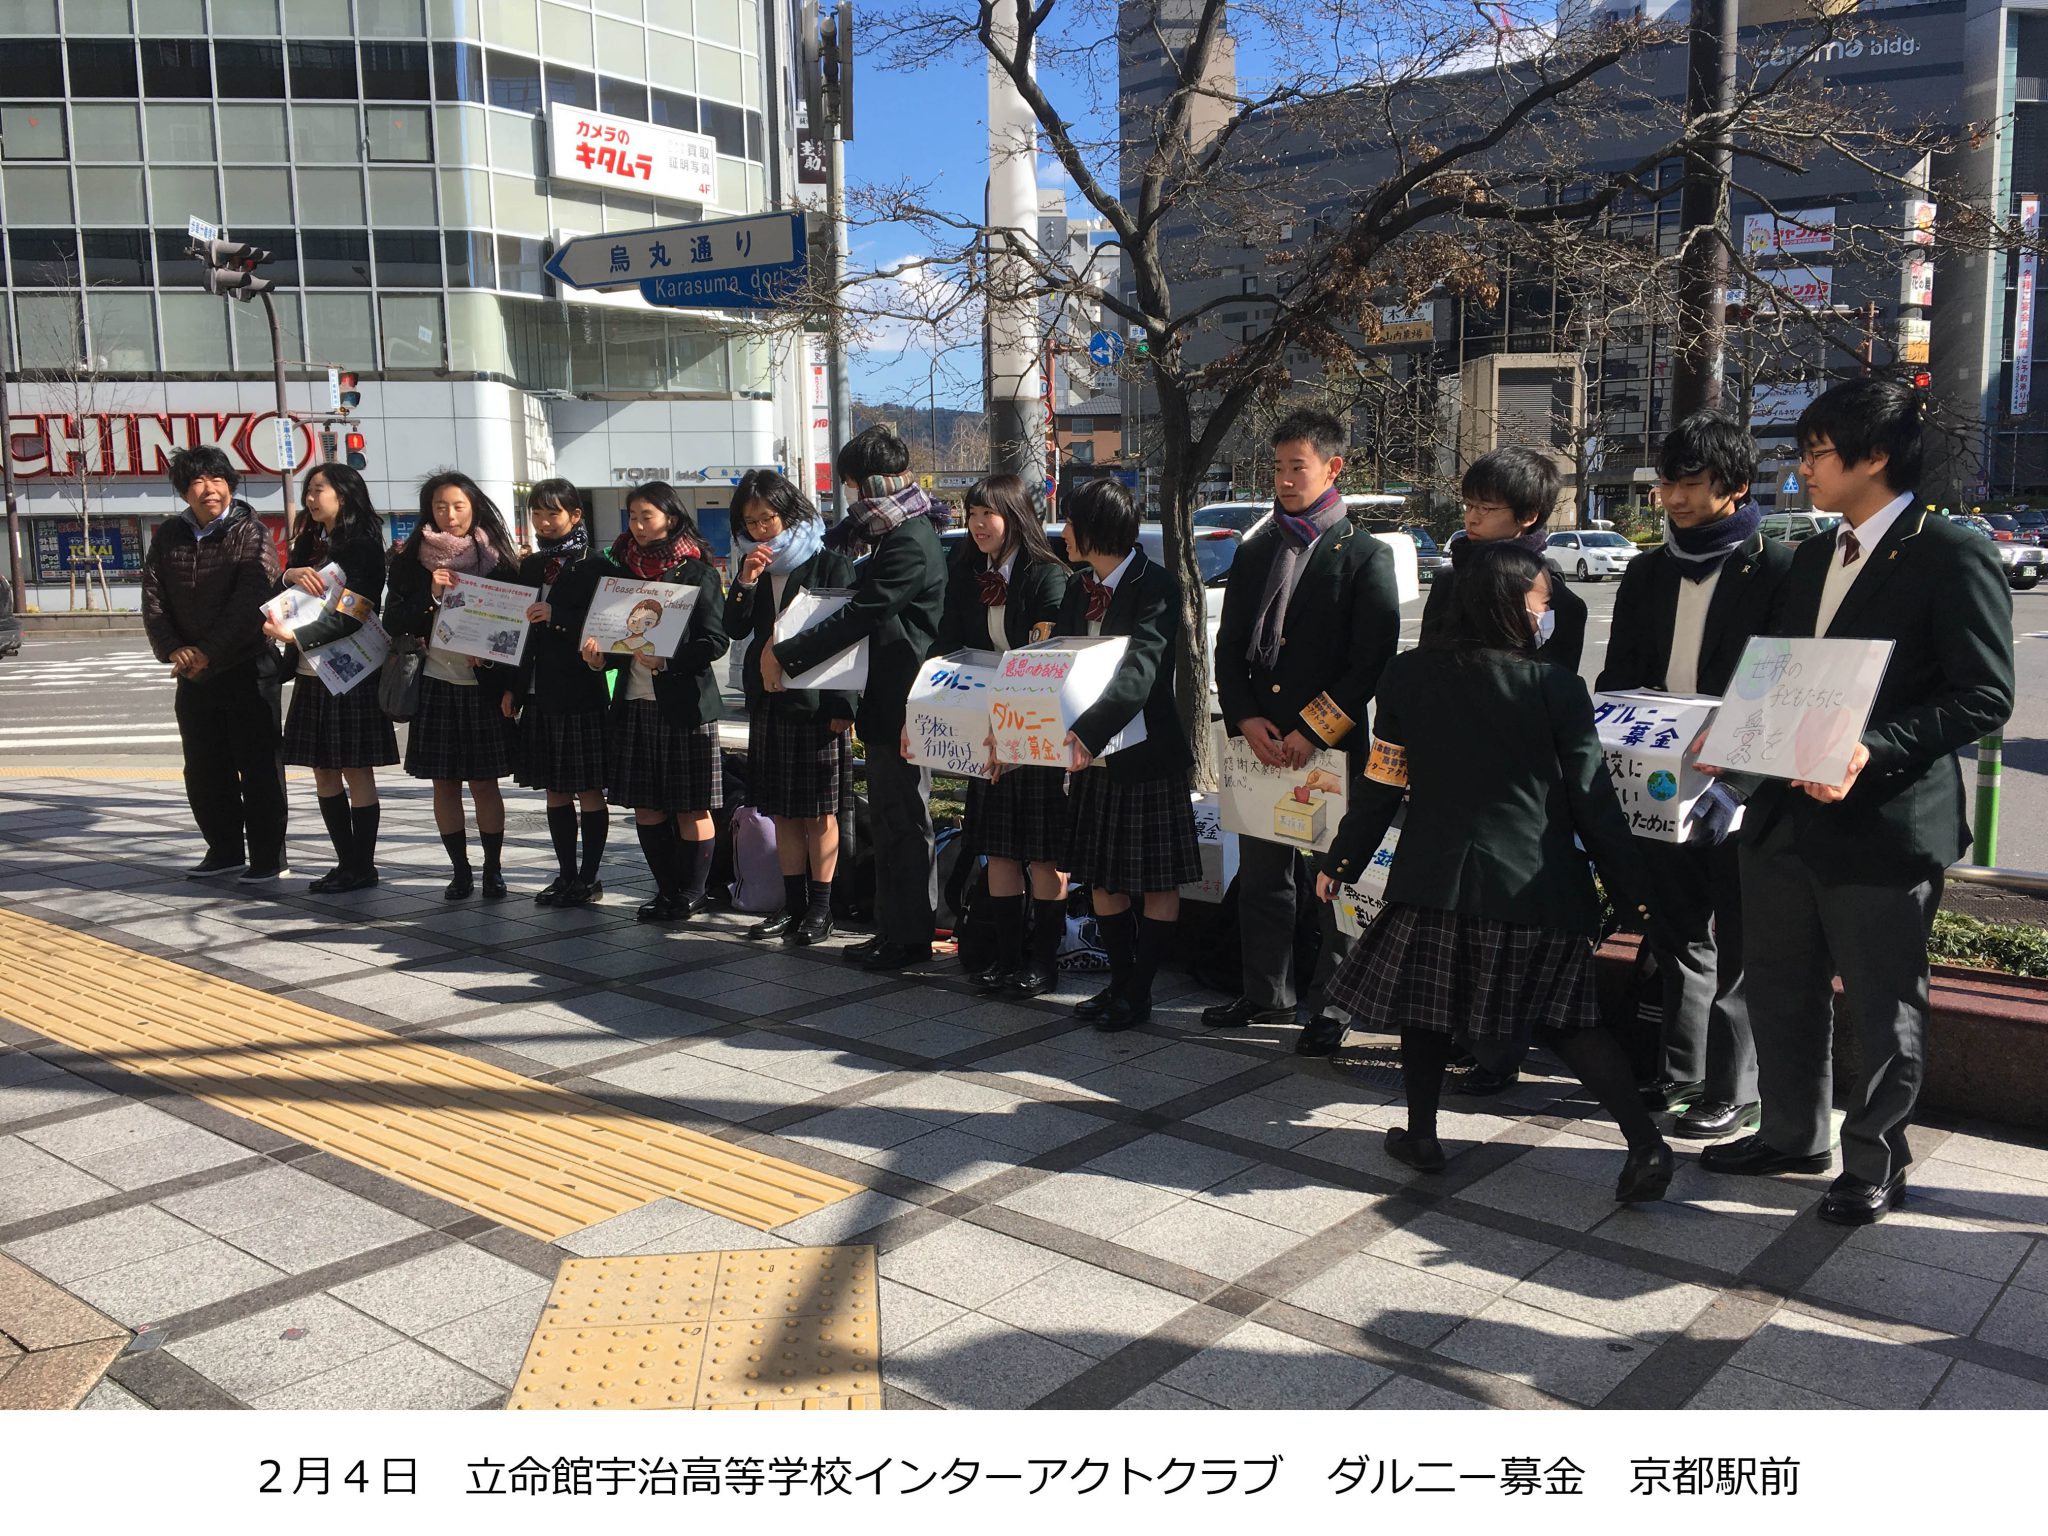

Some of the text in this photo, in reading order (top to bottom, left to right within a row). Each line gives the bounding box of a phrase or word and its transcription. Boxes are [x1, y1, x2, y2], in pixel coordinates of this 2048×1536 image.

[576, 121, 630, 145] カメラの
[576, 142, 653, 181] キタムラ
[698, 183, 711, 195] 4F
[610, 230, 752, 274] 烏丸通り
[655, 275, 740, 299] Karasuma
[604, 578, 674, 596] Please donate to
[664, 600, 694, 611] Children
[930, 670, 987, 691] ダルニー
[1752, 653, 1803, 685] 世界の
[1769, 684, 1845, 709] 子どもたちに
[914, 713, 959, 738] 学校に
[993, 702, 1056, 731] ダルニー
[1594, 702, 1677, 726] ダルニー
[1619, 725, 1680, 749] 募金
